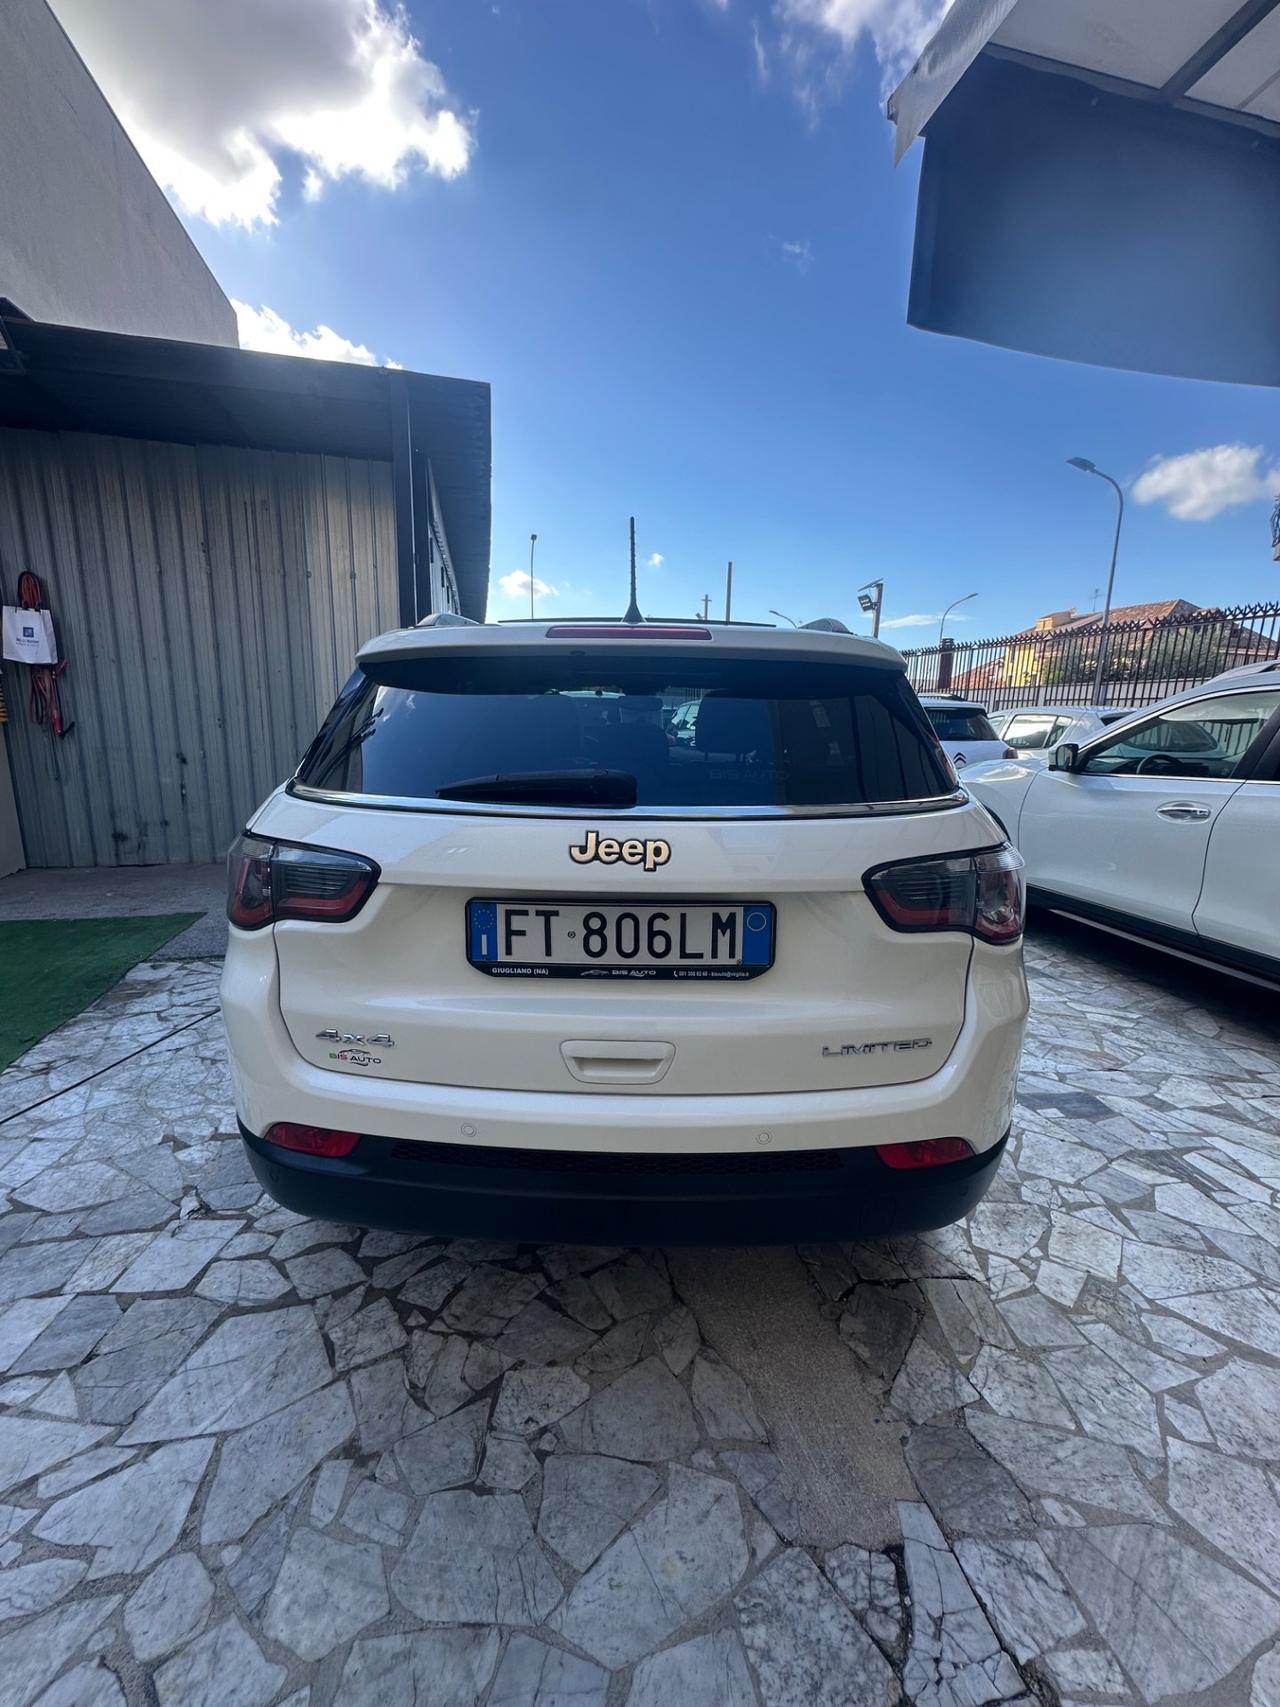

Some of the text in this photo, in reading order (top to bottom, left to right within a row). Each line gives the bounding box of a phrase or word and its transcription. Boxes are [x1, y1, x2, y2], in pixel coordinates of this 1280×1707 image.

[569, 830, 671, 872] Jeep
[504, 909, 737, 959] FT 806LM
[491, 967, 549, 976] GIUGLIANO (NA)
[629, 969, 657, 977] AUTO
[315, 1027, 395, 1048] 4x4
[822, 1038, 933, 1057] LIMITED
[329, 1052, 382, 1064] BIS AUTO
